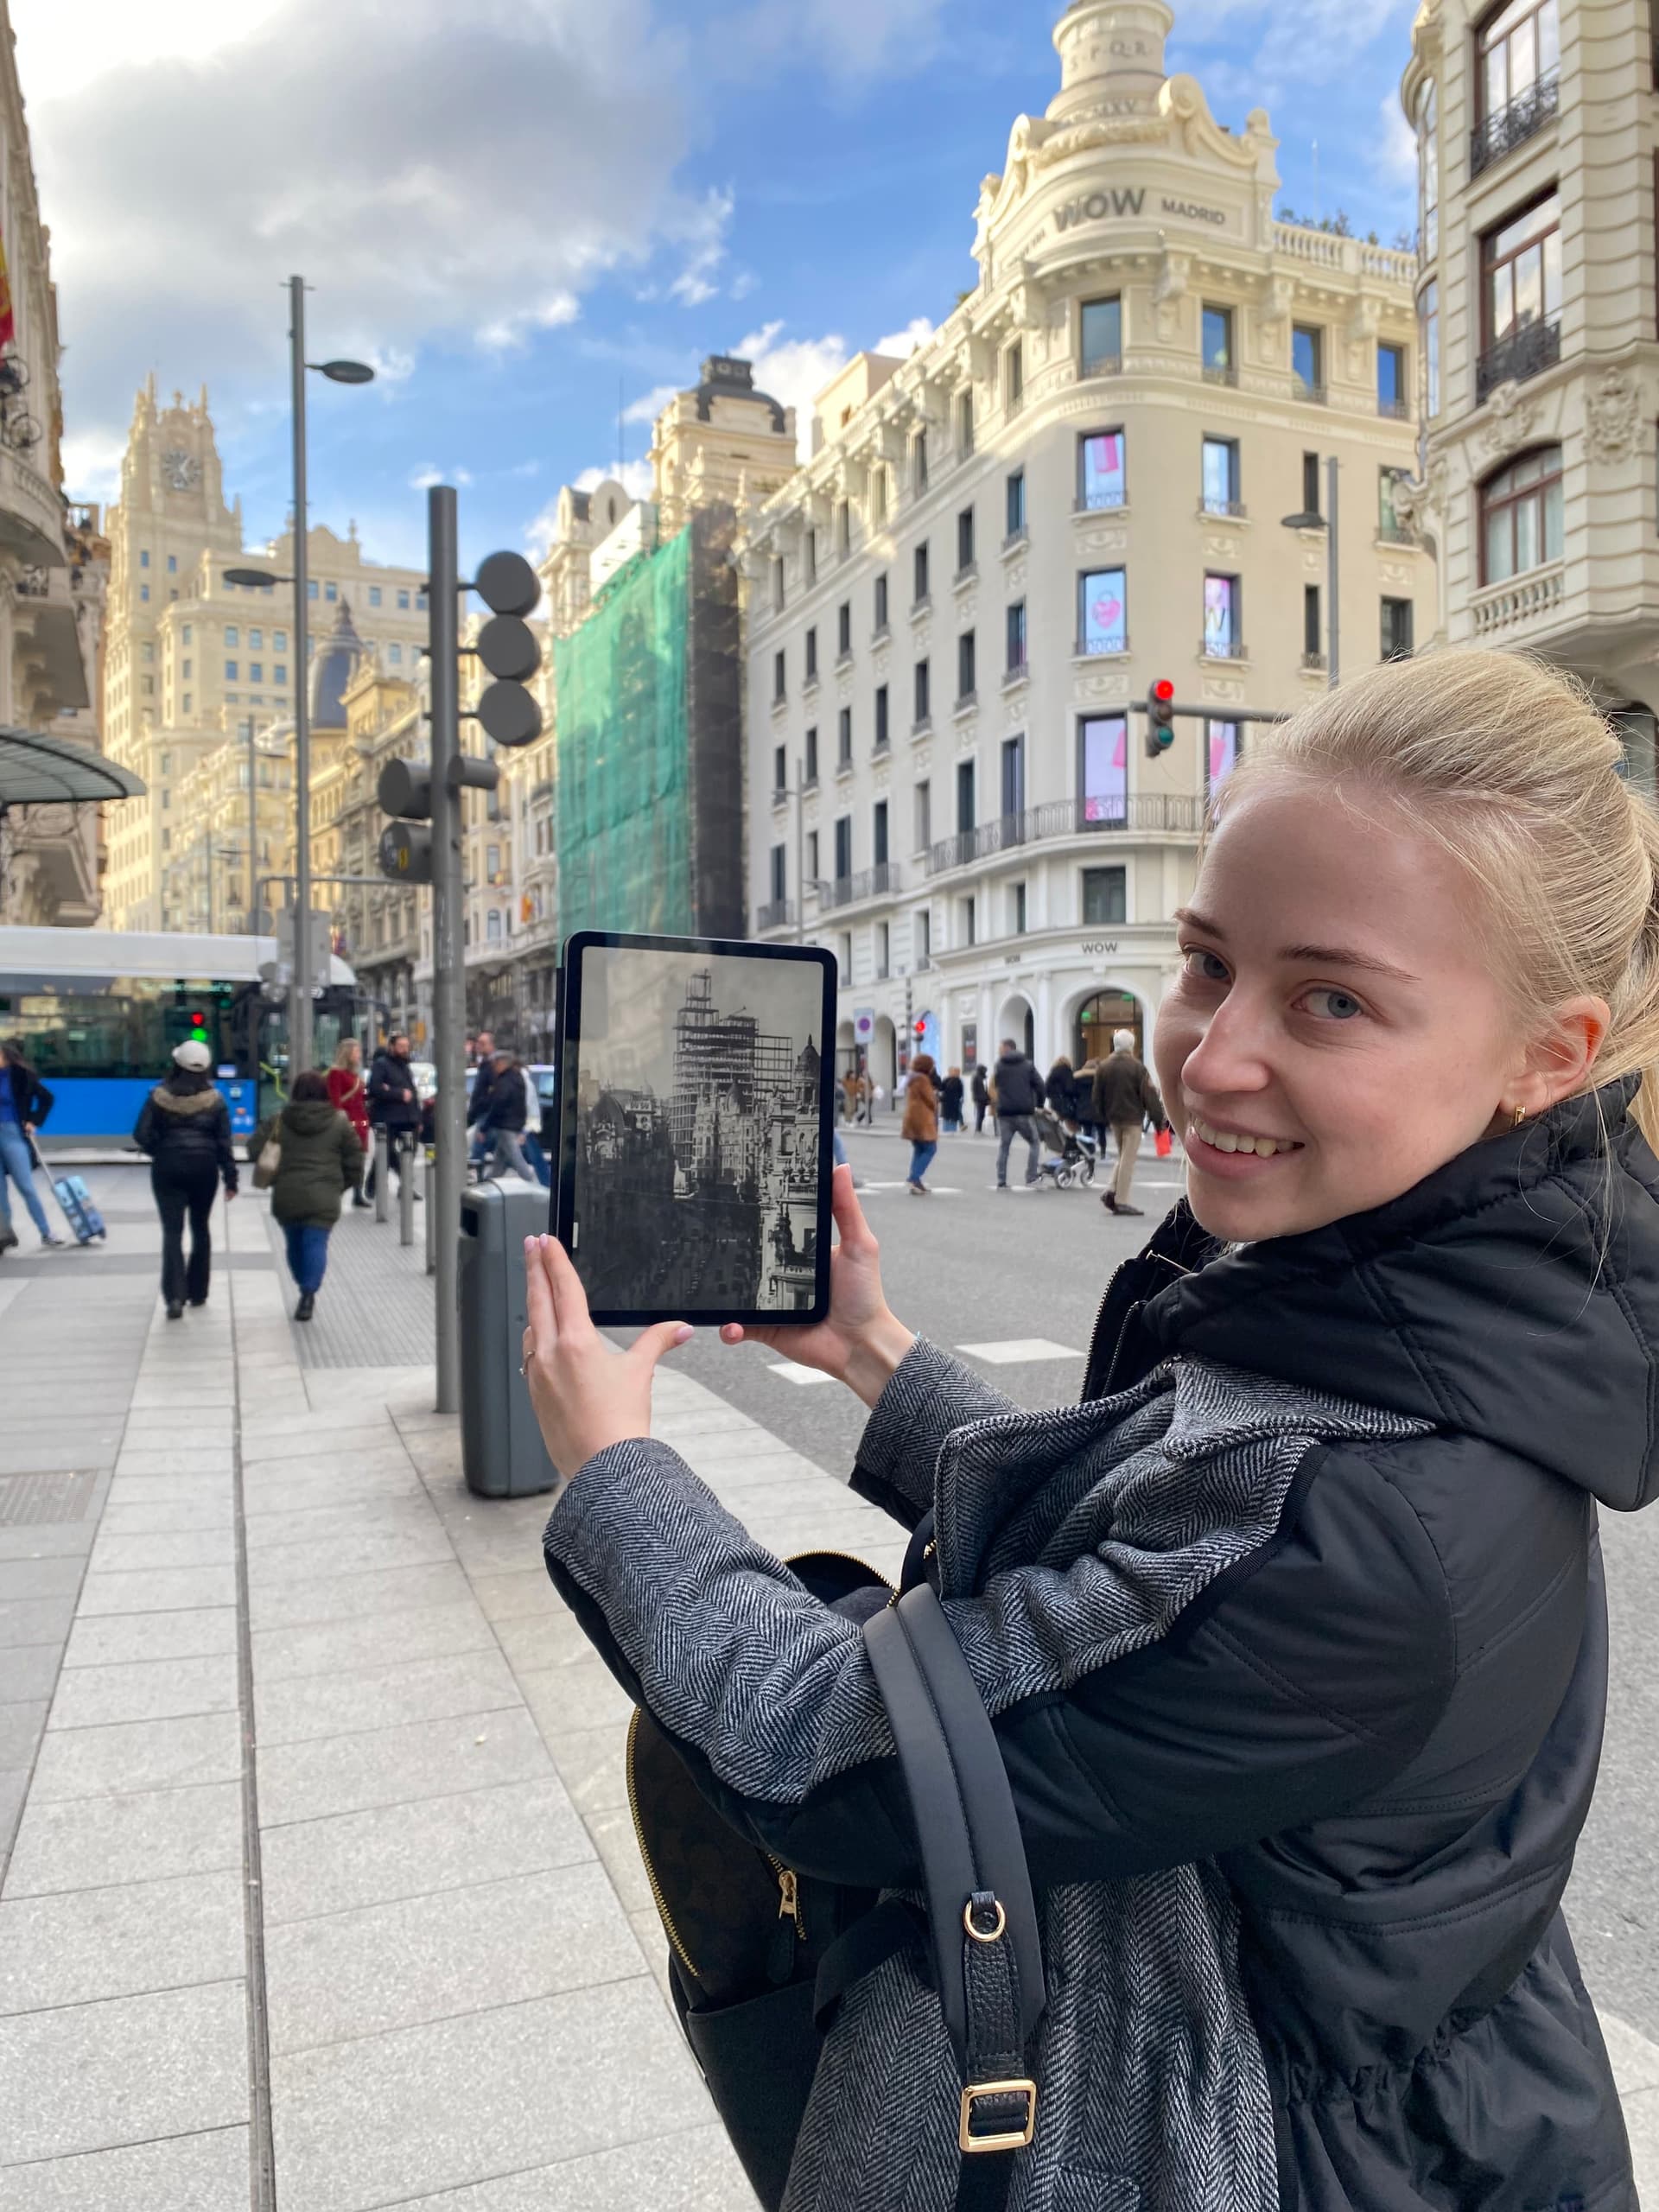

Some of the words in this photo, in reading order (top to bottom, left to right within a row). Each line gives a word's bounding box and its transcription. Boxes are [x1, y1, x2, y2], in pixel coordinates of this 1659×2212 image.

[1053, 188, 1147, 232] WOW
[1161, 199, 1226, 225] MADRID
[1082, 942, 1118, 954] WOW
